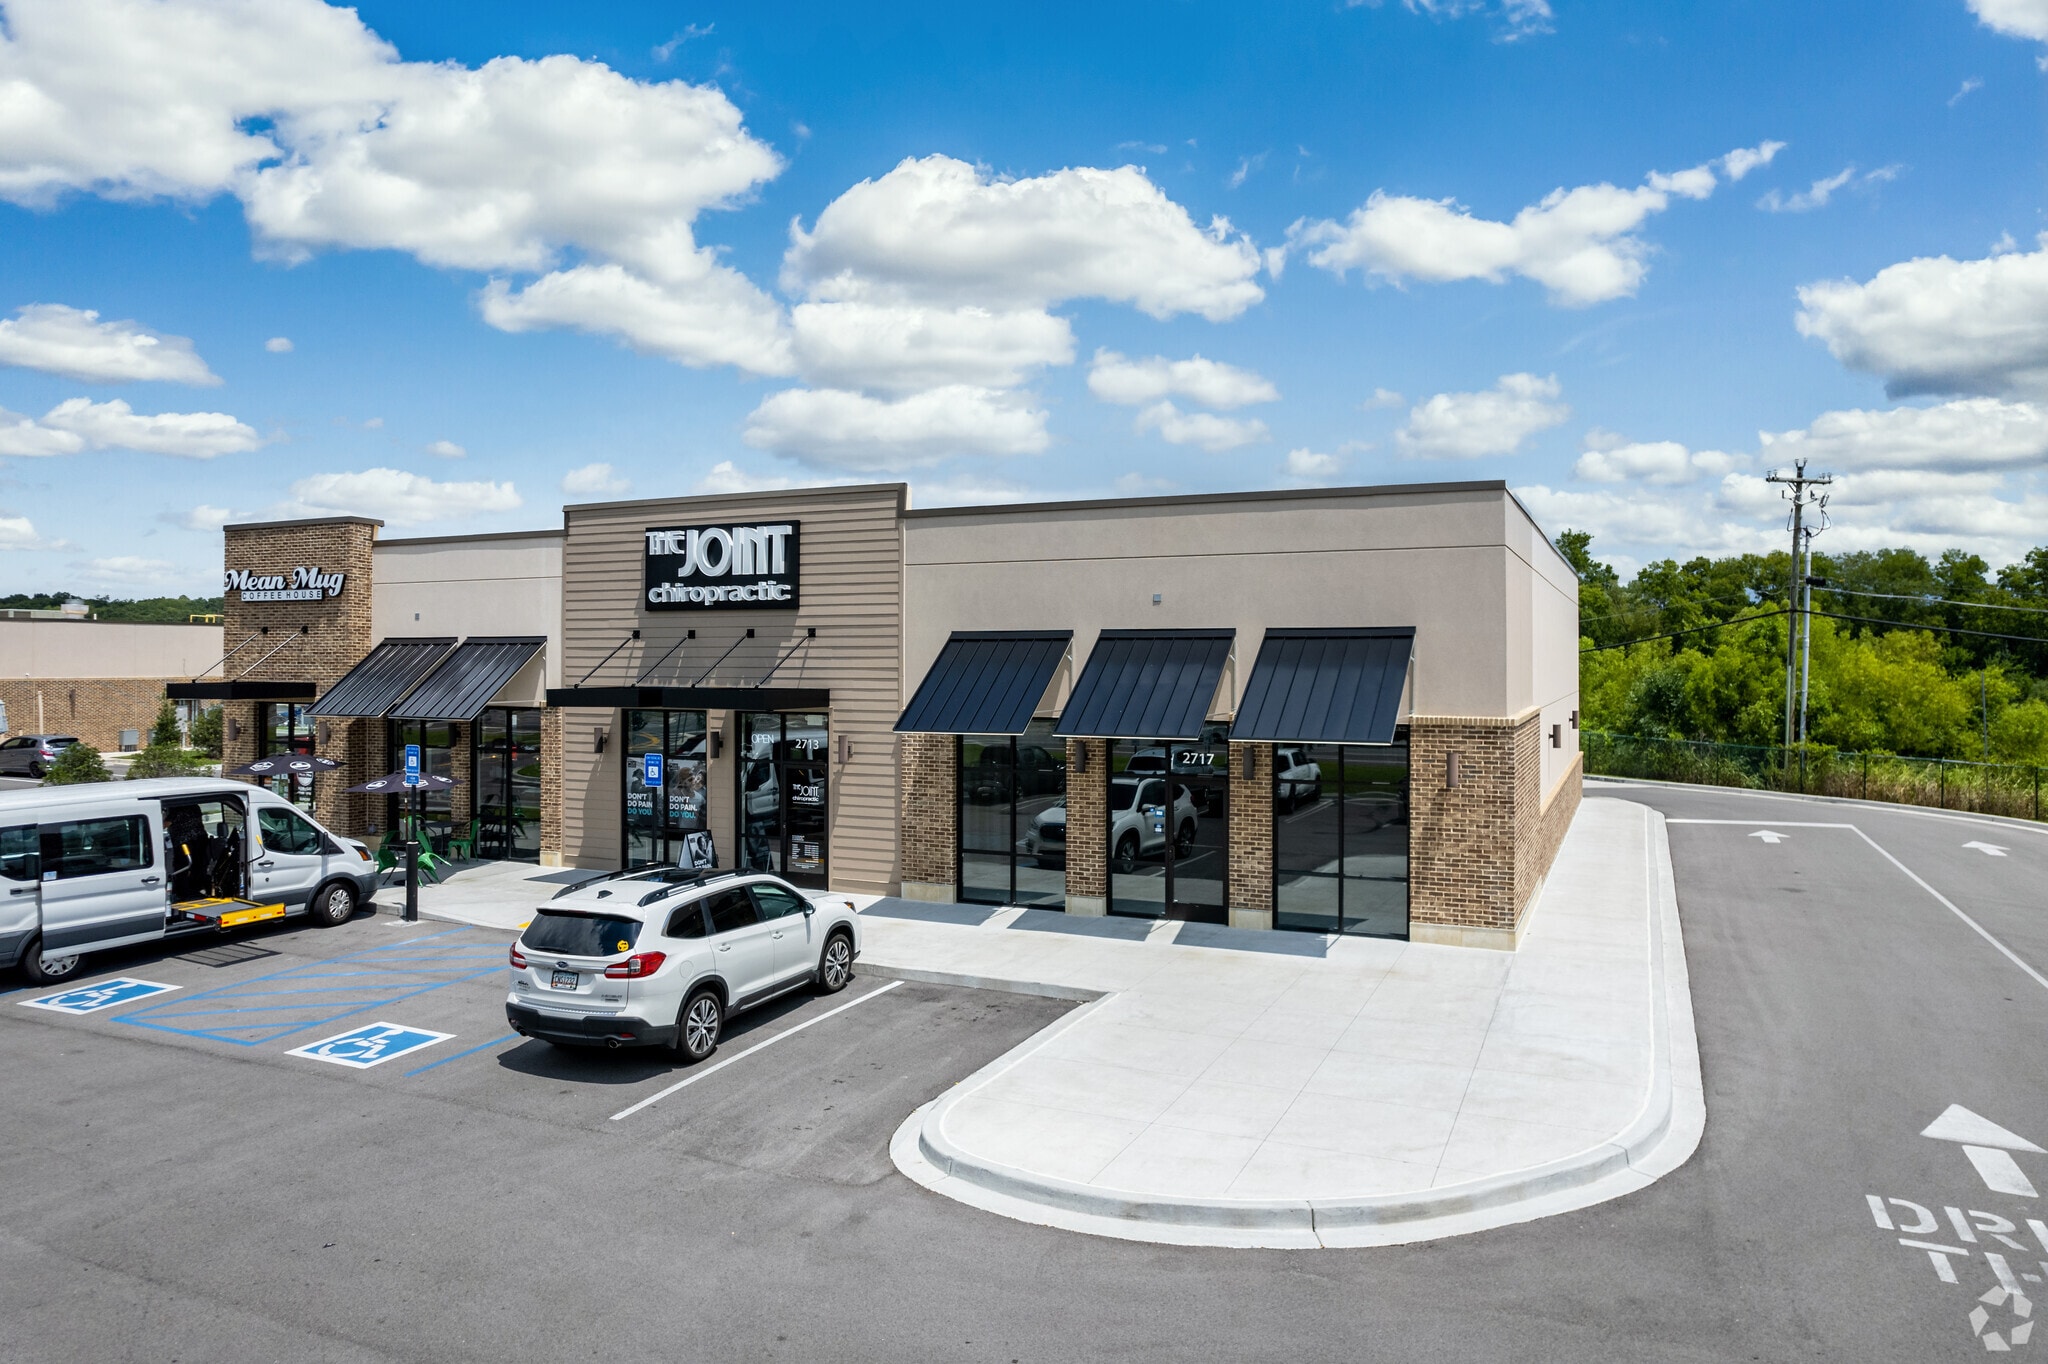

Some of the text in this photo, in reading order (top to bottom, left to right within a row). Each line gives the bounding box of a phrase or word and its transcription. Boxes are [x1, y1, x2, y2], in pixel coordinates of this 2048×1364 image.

[646, 525, 792, 577] THE JOINT
[224, 566, 344, 597] Mean Mug
[242, 590, 321, 600] COFFEE HOUSE
[648, 580, 791, 606] chiropractic
[751, 733, 775, 744] OPEN
[795, 738, 819, 750] 2713
[1182, 752, 1214, 765] 2717
[627, 792, 647, 800] DON'T
[799, 785, 819, 797] JOINT
[669, 795, 690, 803] DON'T
[627, 807, 638, 815] DO
[680, 804, 698, 812] PAIN.
[681, 811, 696, 819] YOU.
